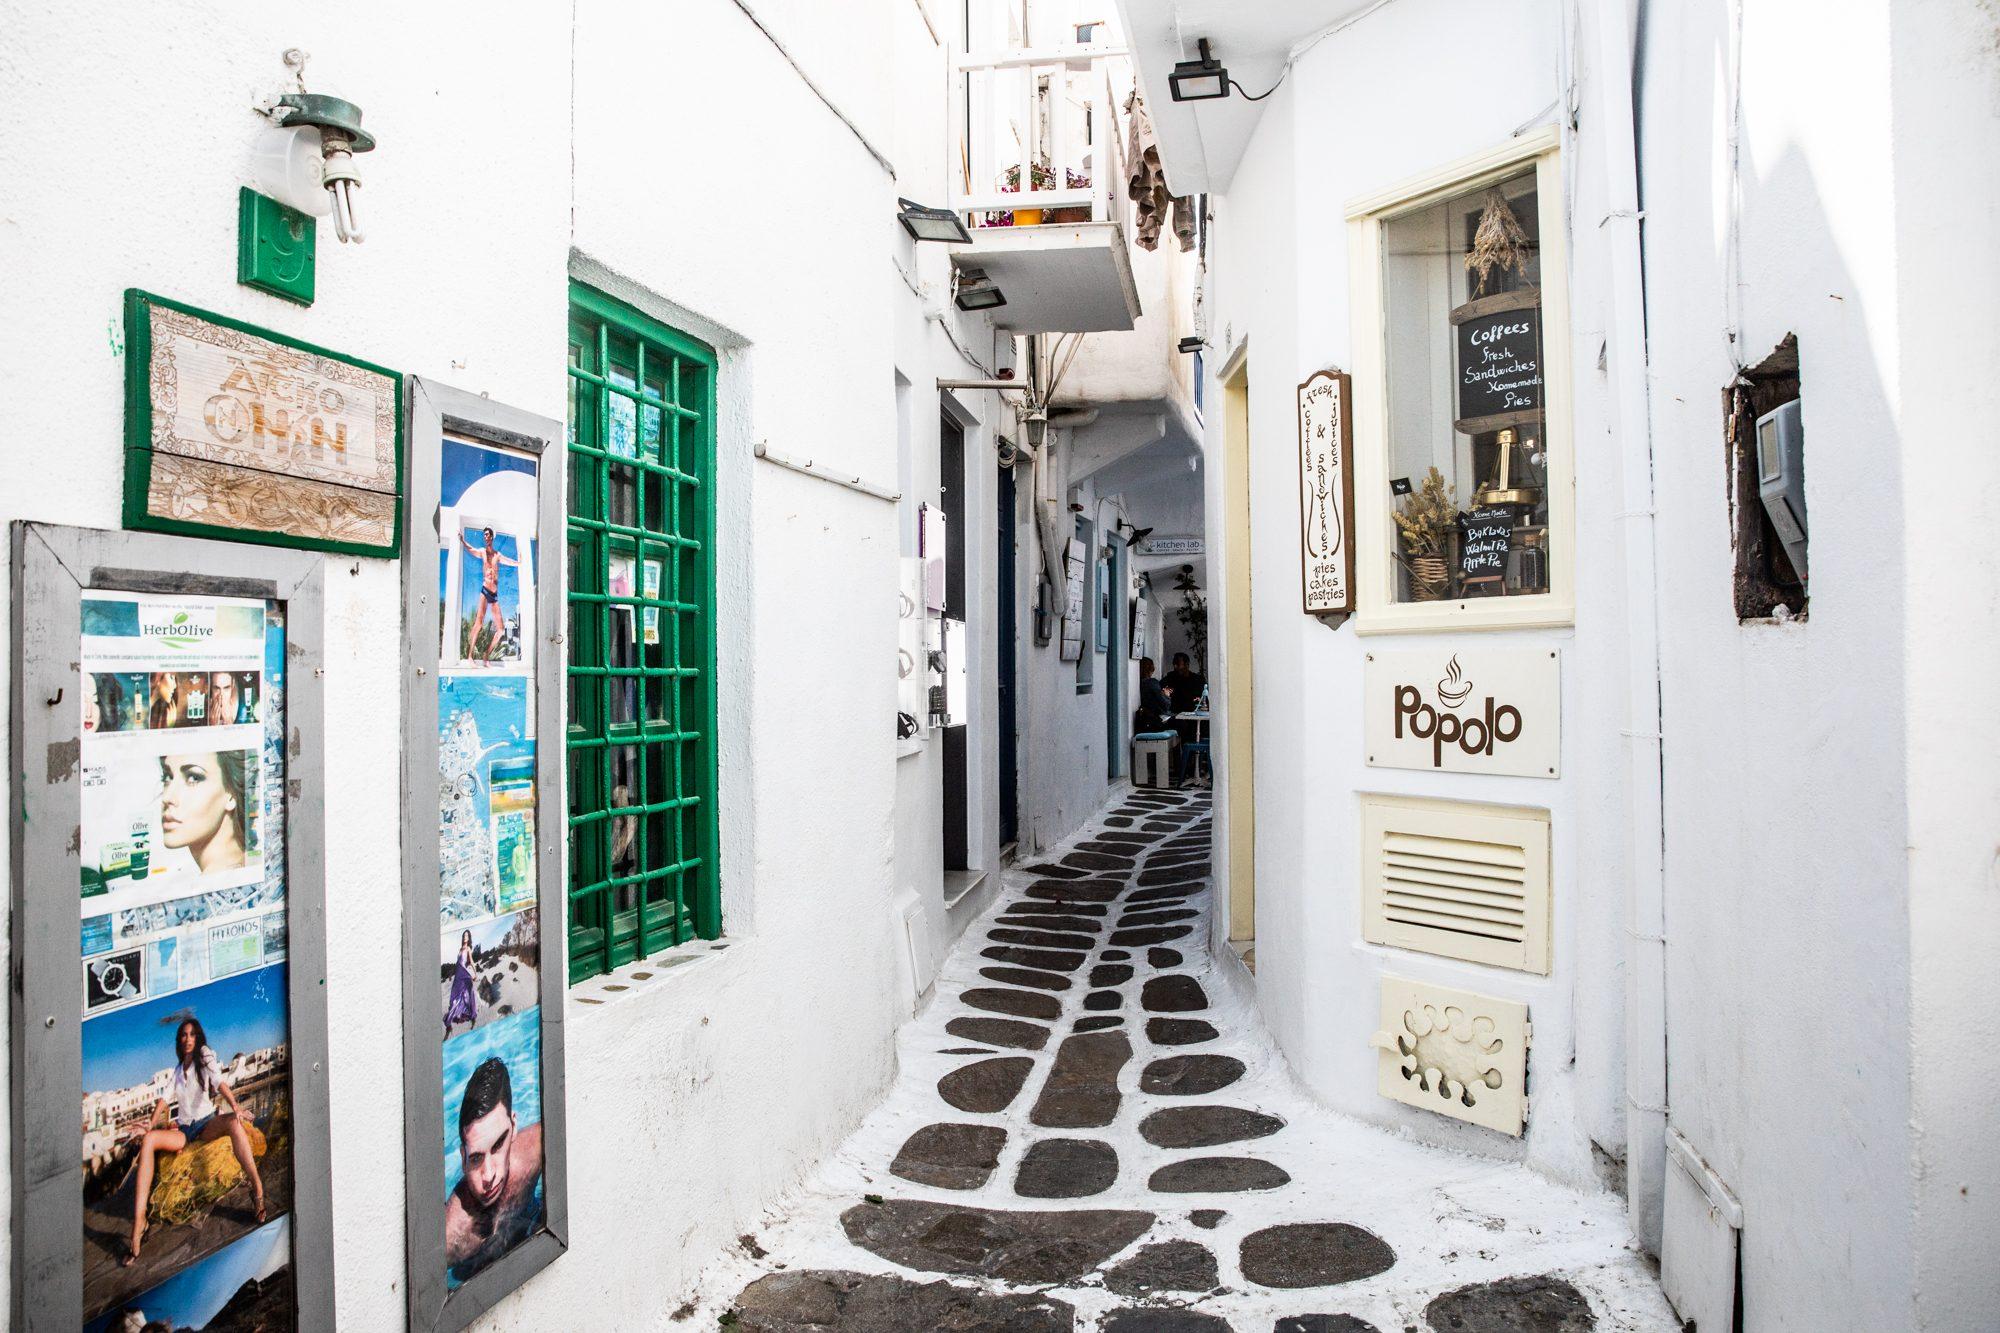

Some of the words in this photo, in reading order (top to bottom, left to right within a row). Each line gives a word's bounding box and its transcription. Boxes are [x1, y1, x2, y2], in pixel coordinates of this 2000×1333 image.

[1470, 322, 1530, 346] Coffees
[1464, 360, 1536, 384] Sandwiches
[1306, 384, 1333, 405] fresh
[1503, 391, 1532, 409] Pies
[1330, 402, 1339, 467] juices
[1156, 541, 1186, 549] kitchen
[1187, 540, 1200, 548] lab
[1496, 540, 1509, 552] Pie
[1313, 562, 1336, 578] pies
[1463, 554, 1487, 573] Apple
[1487, 552, 1502, 567] Pie
[1309, 575, 1339, 590] cakes
[1308, 588, 1345, 606] pastries
[143, 624, 214, 636] HerbOlive
[1394, 684, 1523, 768] Popolo
